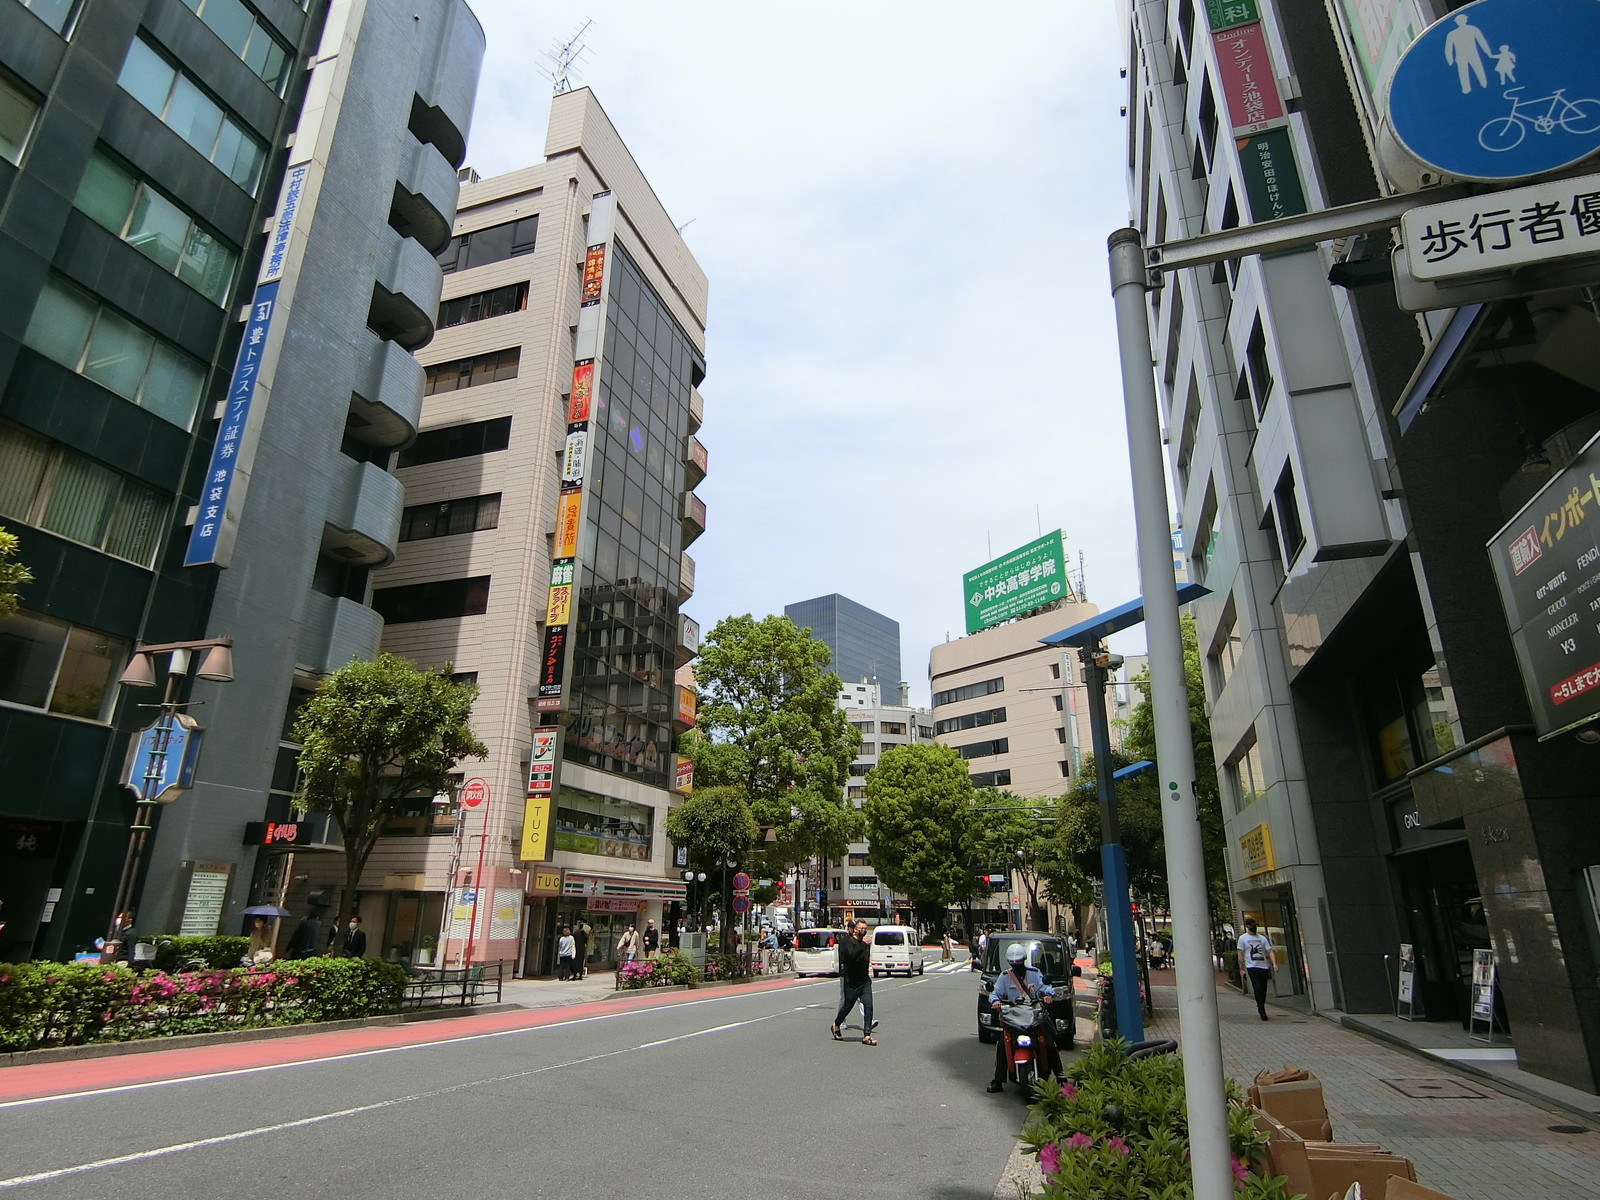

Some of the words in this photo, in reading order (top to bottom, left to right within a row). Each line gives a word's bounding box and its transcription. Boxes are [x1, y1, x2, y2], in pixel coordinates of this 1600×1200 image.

[1222, 0, 1250, 22] 科
[1249, 122, 1269, 132] 3階
[1420, 193, 1600, 264] 歩行者優
[220, 325, 265, 460] 豊トラスティ証券
[200, 469, 226, 538] 池袋支店
[1510, 532, 1540, 569] 直輸入
[1576, 545, 1600, 571] FENDI
[551, 565, 573, 585] 麻雀
[984, 558, 1056, 602] 中央高等学院
[1536, 571, 1567, 600] OFF-WHITE
[559, 587, 569, 613] スリー
[1547, 596, 1567, 616] GUCCI
[1547, 612, 1579, 640] MONCLER
[274, 823, 298, 842] HUB
[531, 806, 542, 843] TUC
[537, 875, 559, 887] TUC
